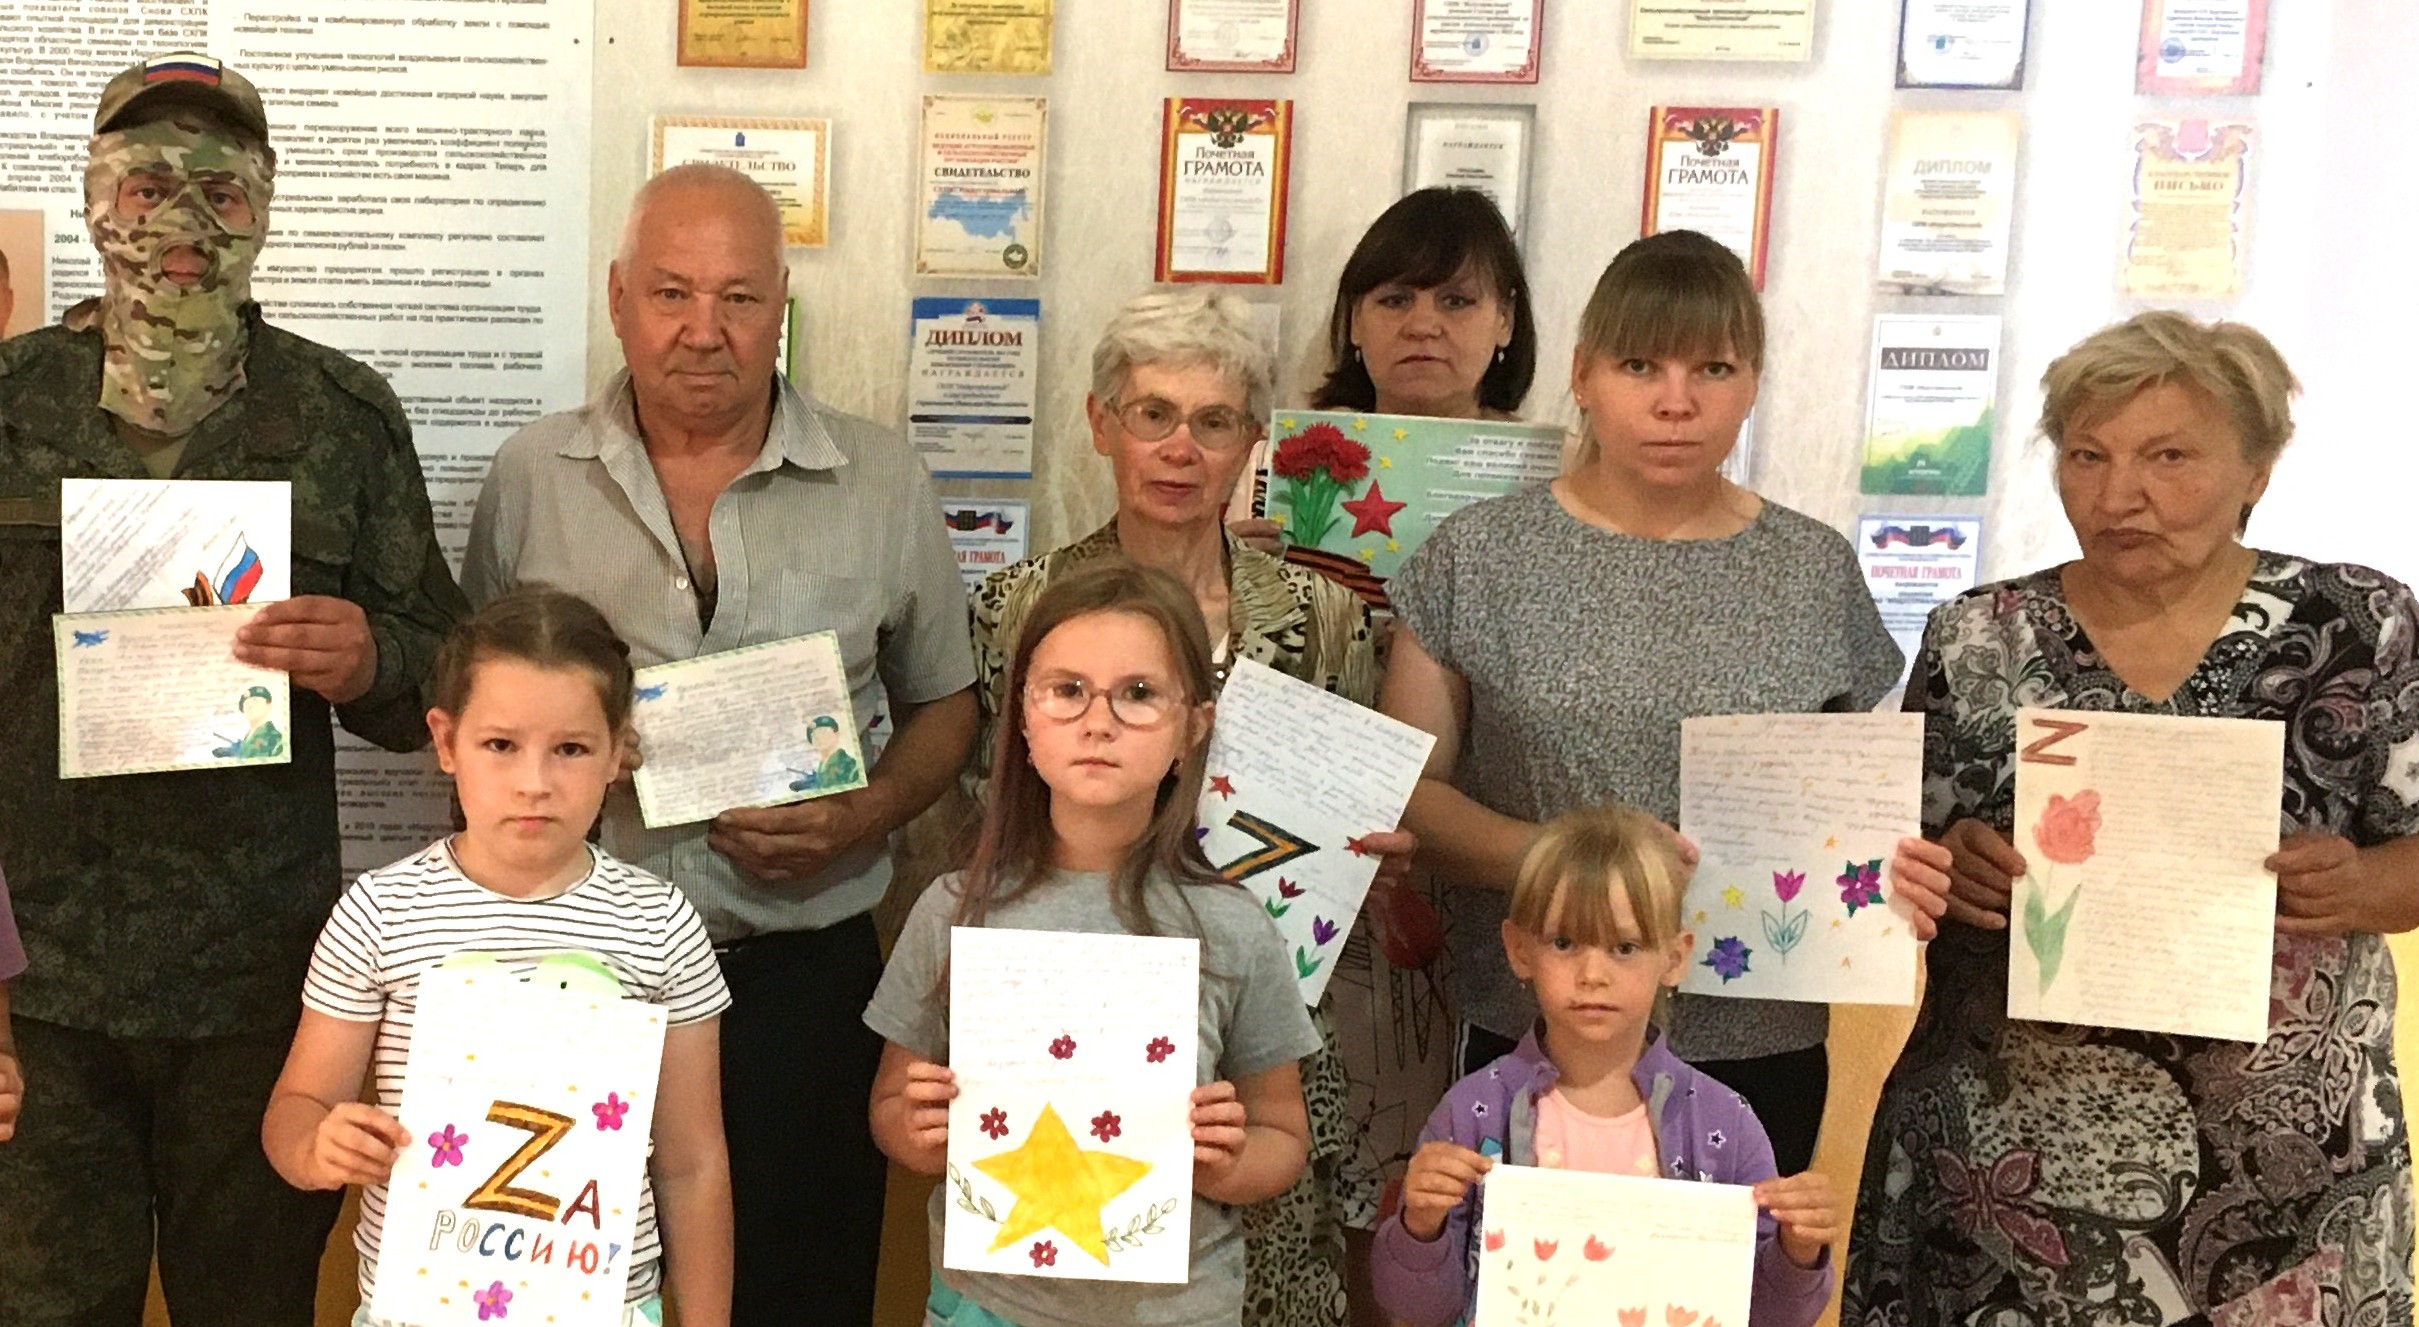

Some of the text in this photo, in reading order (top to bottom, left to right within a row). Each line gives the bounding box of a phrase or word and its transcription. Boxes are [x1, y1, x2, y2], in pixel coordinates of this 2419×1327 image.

[1195, 146, 1256, 160] Почетная
[1680, 154, 1740, 168] Почетная
[934, 166, 1032, 179] СВИДЕТЕЛЬСТВО
[1183, 160, 1265, 177] ГРАМОТА
[1913, 159, 1993, 176] ДИПЛОМ
[1667, 168, 1750, 185] ГРАМОТА
[925, 329, 1023, 348] ДИПЛОМ
[1883, 351, 1986, 368] ДИПЛОМ
[921, 369, 1025, 379] НАГРАЖДАЕТСЯ
[2021, 718, 2089, 766] Z
[428, 1208, 622, 1276] РОССИЮ!
